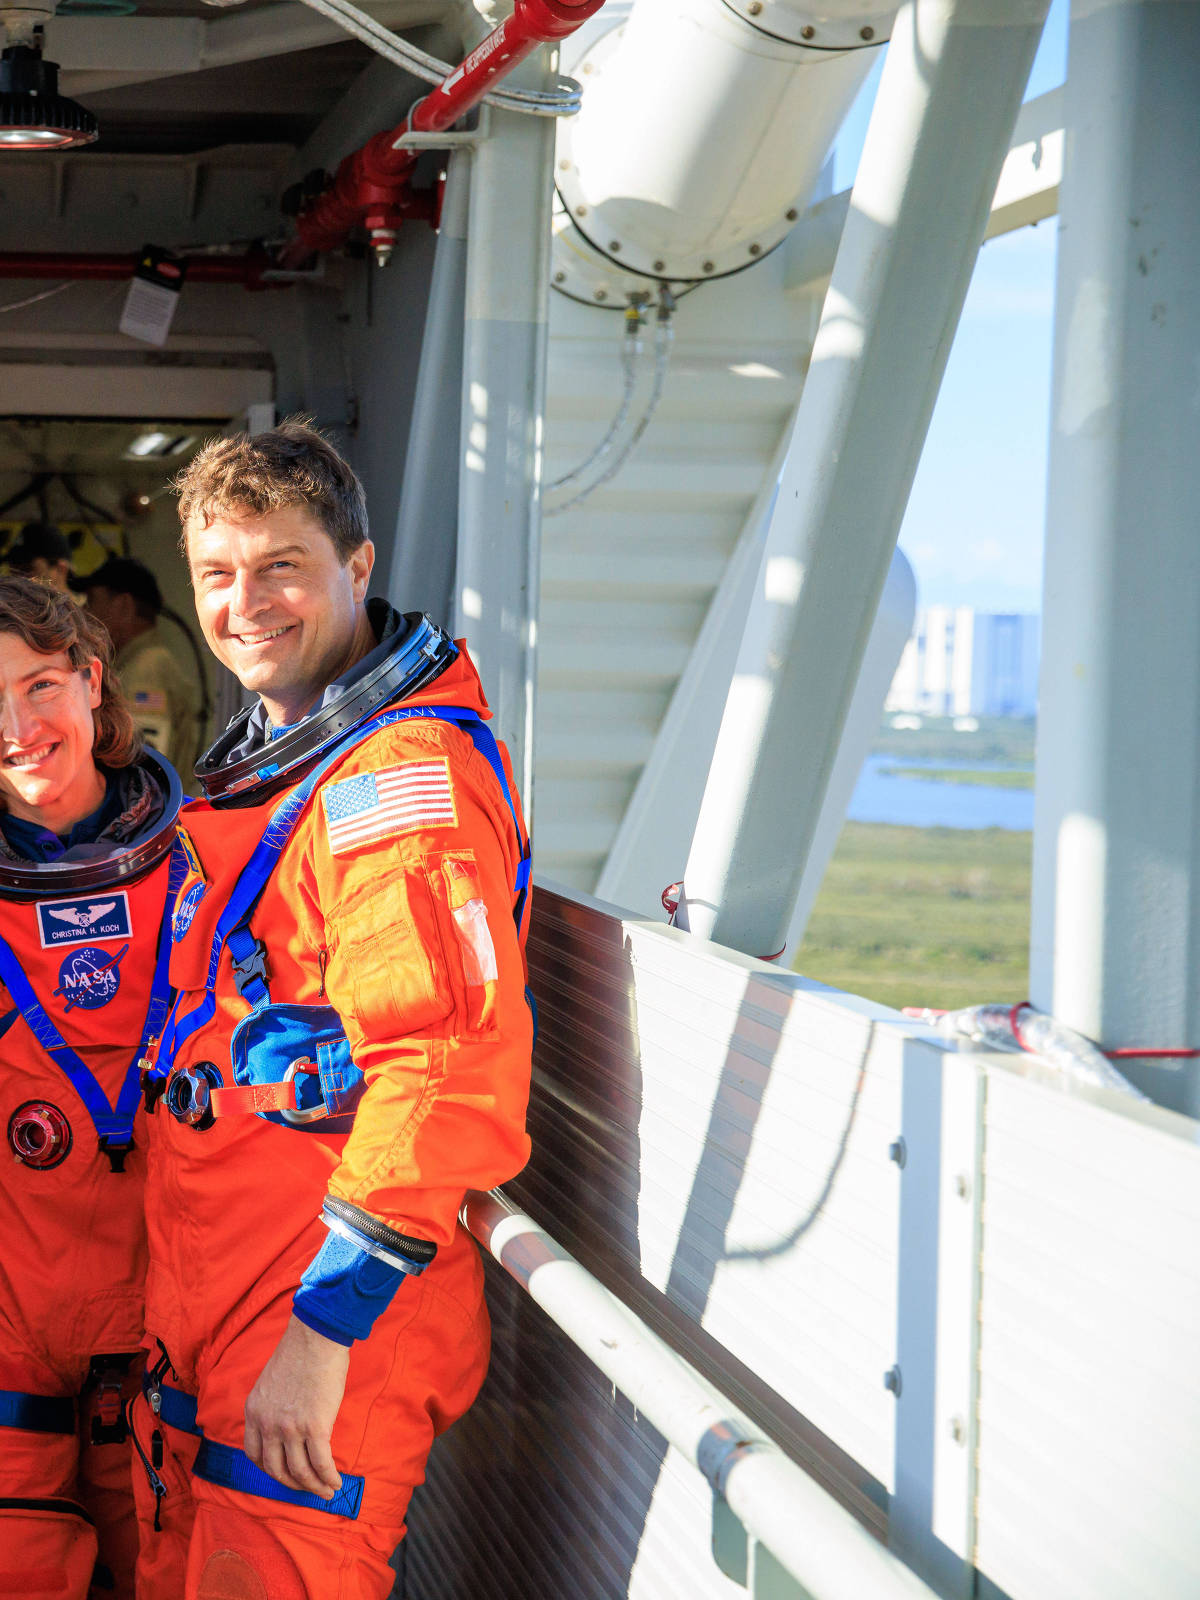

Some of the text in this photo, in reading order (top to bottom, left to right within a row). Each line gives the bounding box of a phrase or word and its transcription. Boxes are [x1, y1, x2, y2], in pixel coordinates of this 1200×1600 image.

[51, 928, 87, 939] CHRISTINA
[100, 924, 120, 933] KOCH
[63, 968, 117, 988] NASA
